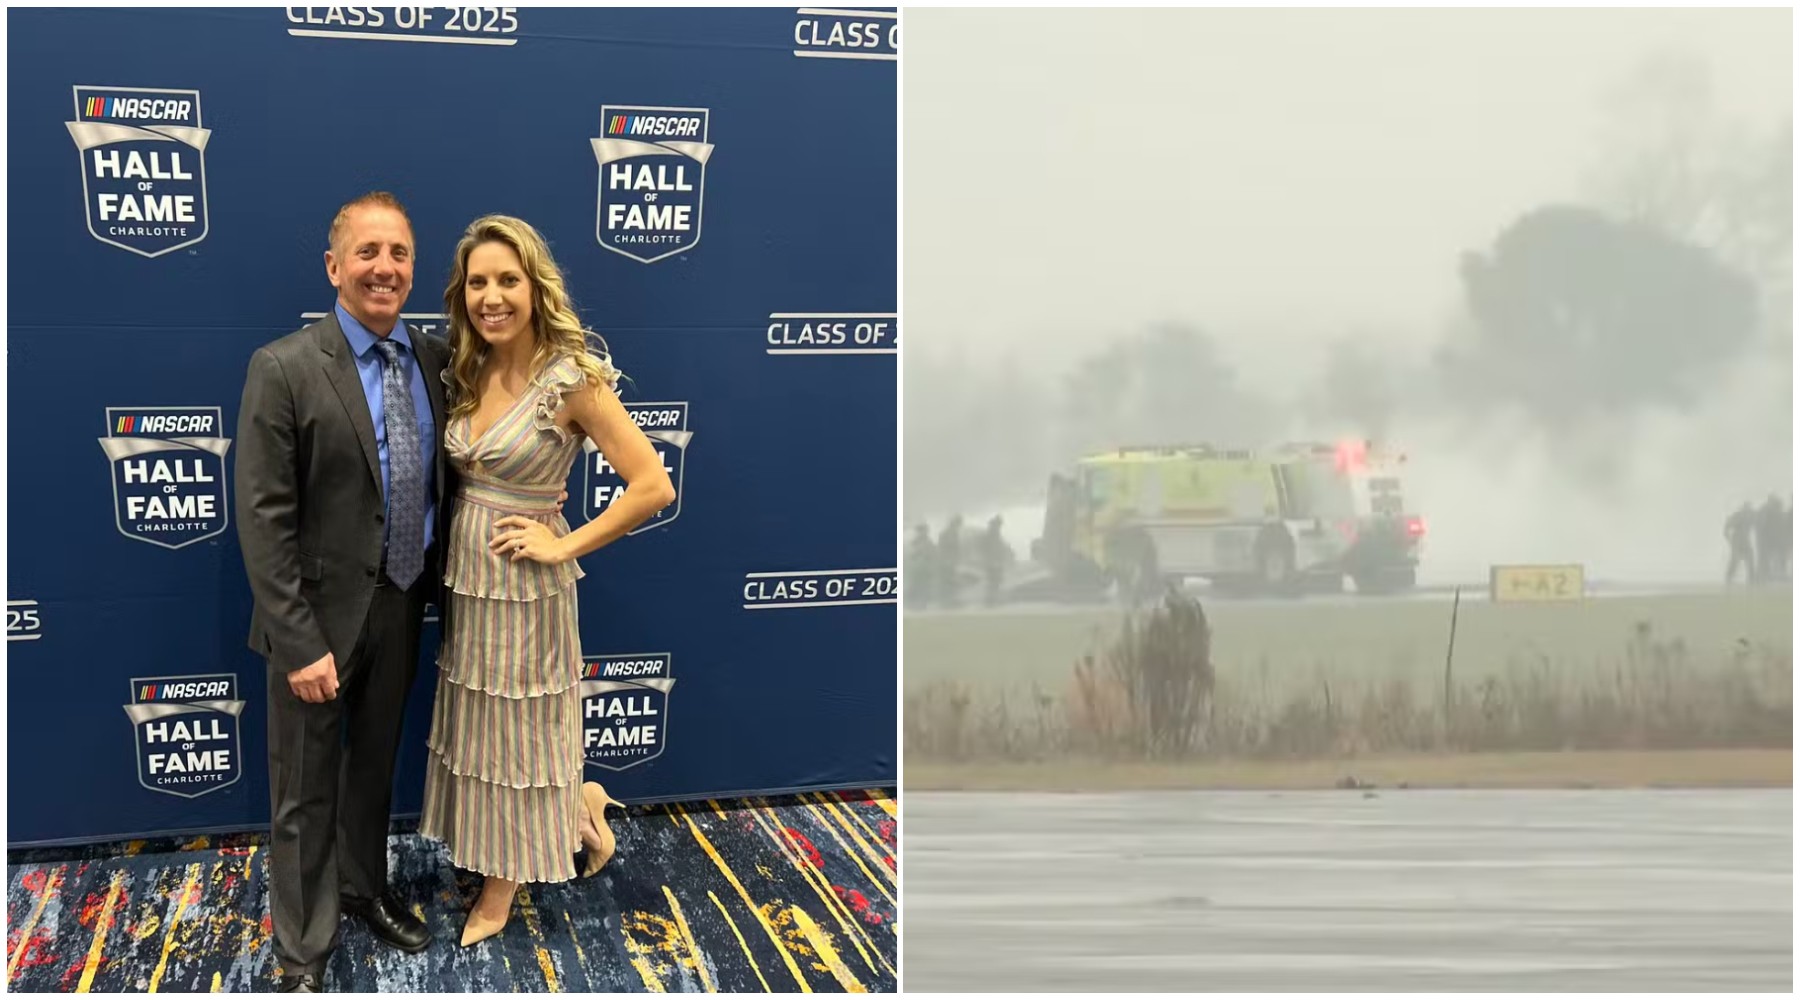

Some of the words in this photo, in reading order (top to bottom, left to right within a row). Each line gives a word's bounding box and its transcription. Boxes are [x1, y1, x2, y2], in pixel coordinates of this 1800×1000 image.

[286, 7, 384, 26] CLASS
[395, 7, 434, 28] OF
[445, 7, 517, 31] 2025
[795, 20, 880, 47] CLASS
[111, 97, 190, 120] NASCAR
[631, 117, 700, 136] NASCAR
[94, 150, 192, 179] HALL
[138, 181, 153, 190] OF
[611, 165, 692, 190] HALL
[645, 193, 657, 201] OF
[98, 194, 195, 222] FAME
[608, 205, 690, 230] FAME
[110, 226, 187, 236] CHARLOTTE
[614, 235, 681, 243] CHARLOTTE
[767, 323, 846, 344] CLASS
[854, 323, 887, 344] OF
[141, 416, 213, 432] NASCAR
[628, 411, 680, 426] ASCAR
[124, 460, 213, 483] HALL
[164, 485, 177, 493] OF
[127, 495, 216, 519] FAME
[136, 523, 208, 531] CHARLOTTE
[744, 580, 818, 600] CLASS
[826, 579, 856, 596] OF
[603, 660, 663, 676] NASCAR
[162, 682, 229, 698] NASCAR
[586, 696, 657, 718] HALL
[146, 720, 228, 743] HALL
[585, 726, 656, 747] FAME
[148, 750, 230, 773] FAME
[590, 748, 648, 757] CHARLOTTE
[157, 774, 222, 784] CHARLOTTE
